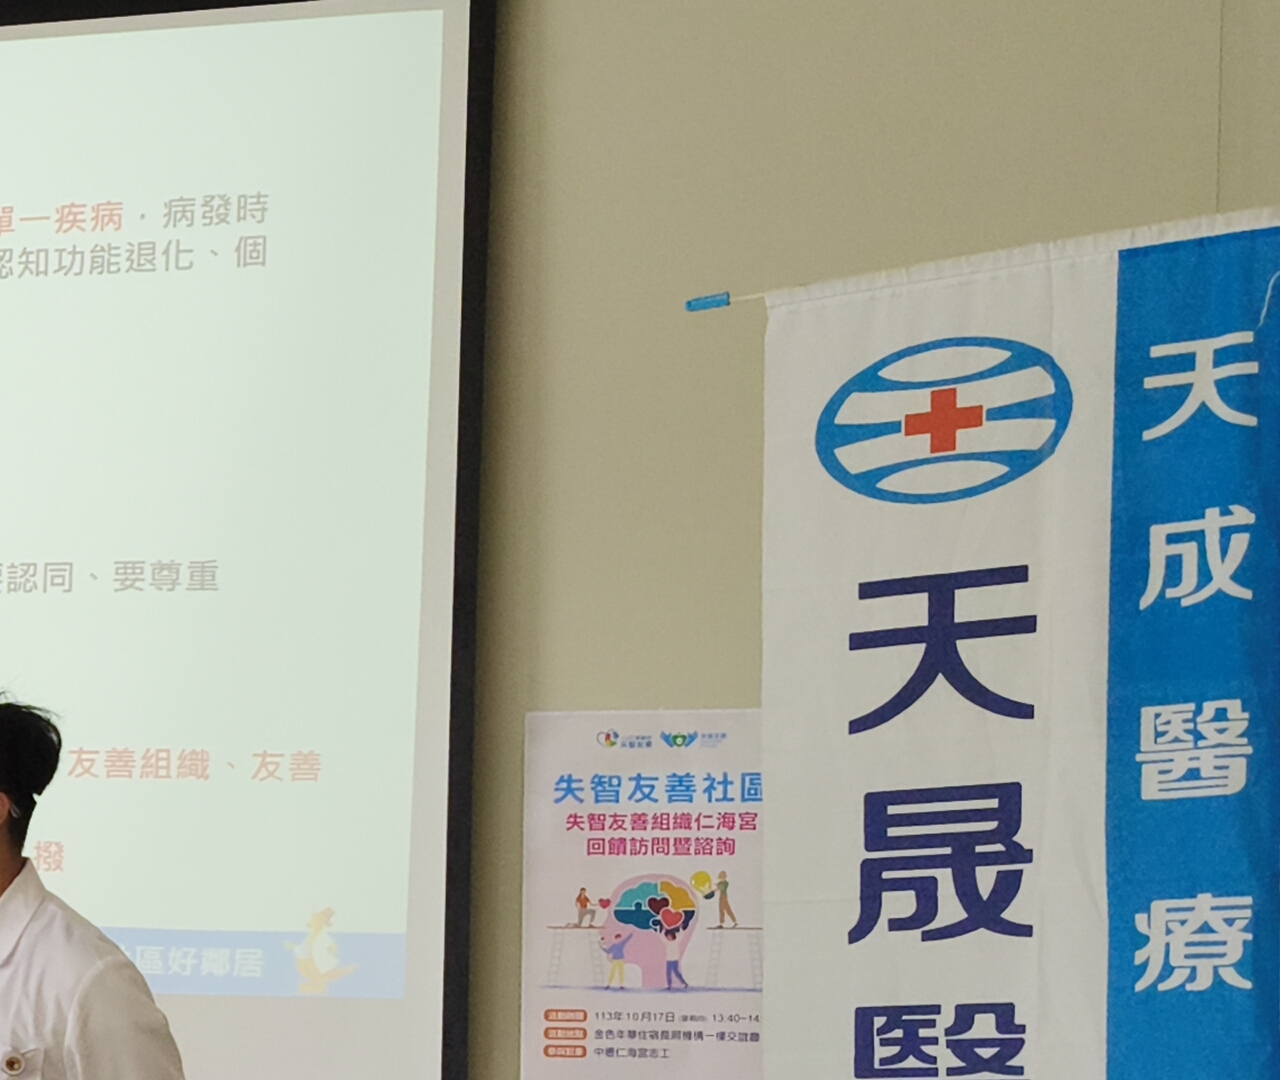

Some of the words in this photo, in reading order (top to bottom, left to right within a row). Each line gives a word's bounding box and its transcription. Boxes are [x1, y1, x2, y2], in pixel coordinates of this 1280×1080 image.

[66, 747, 322, 783] 友善組織、友善
[553, 772, 763, 805] 失智友善社區
[566, 811, 758, 832] 失智友善組織仁海宮
[586, 837, 736, 856] 回饋訪問暨諮詢
[120, 944, 264, 978] 區好鄰居
